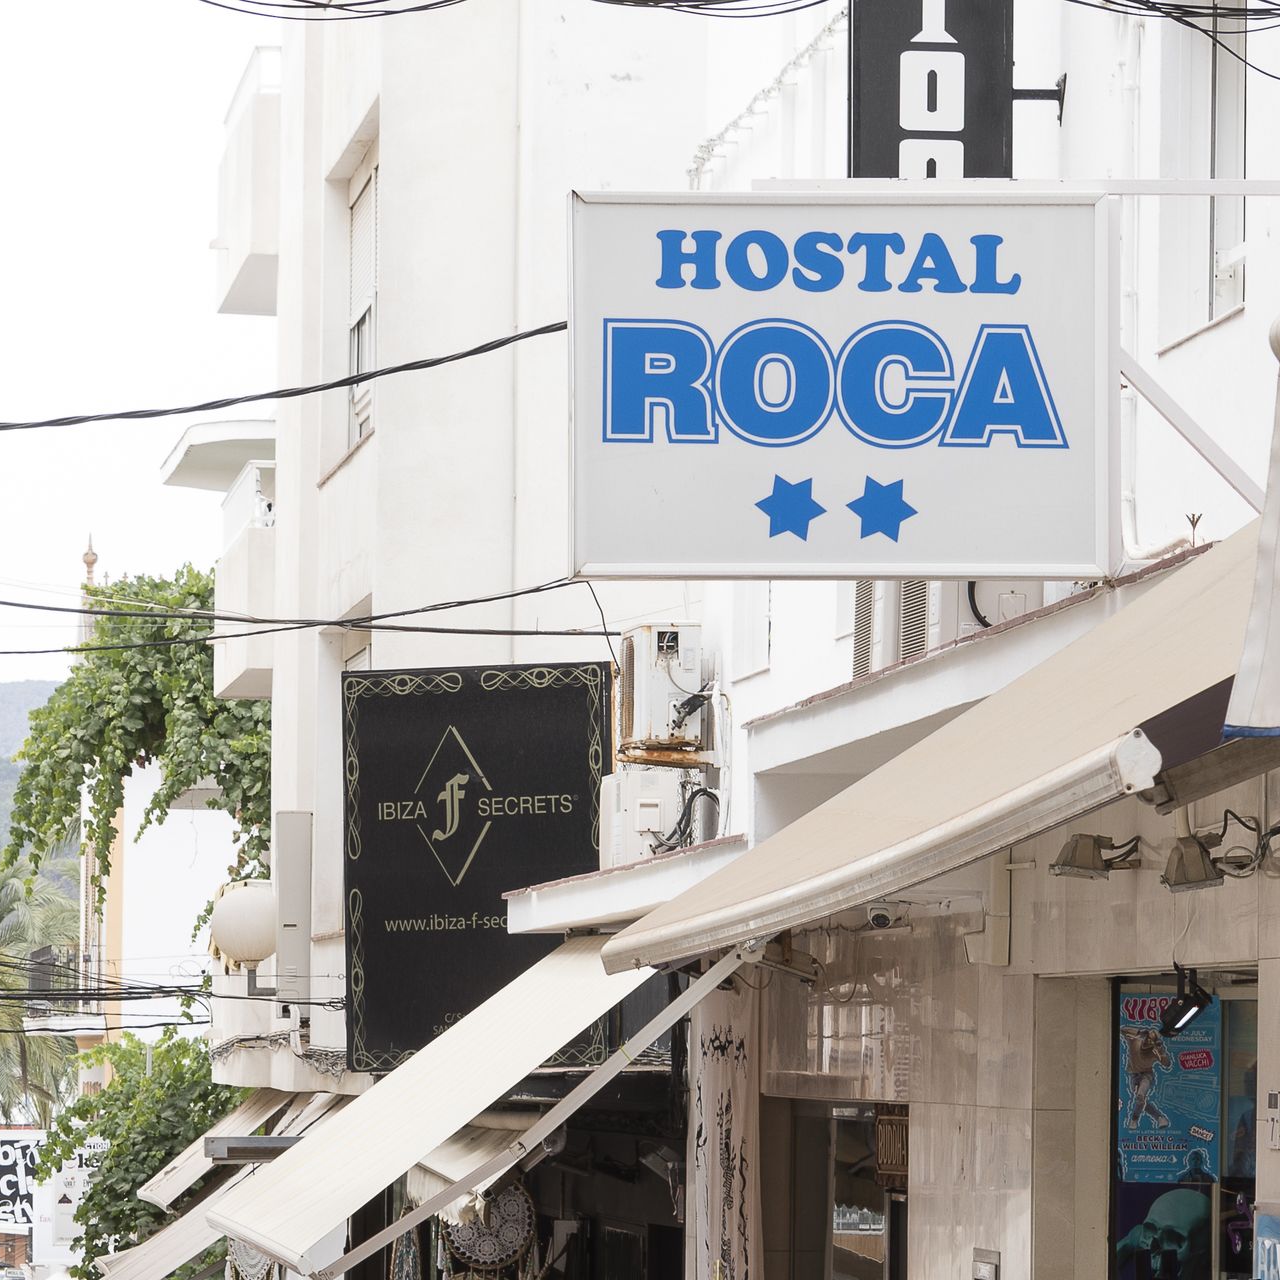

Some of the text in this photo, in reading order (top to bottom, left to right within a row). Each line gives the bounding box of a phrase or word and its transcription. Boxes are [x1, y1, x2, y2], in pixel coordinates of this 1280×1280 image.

[655, 229, 1022, 295] HOSTAL
[602, 317, 1070, 450] ROCA
[378, 801, 427, 821] IBIZA
